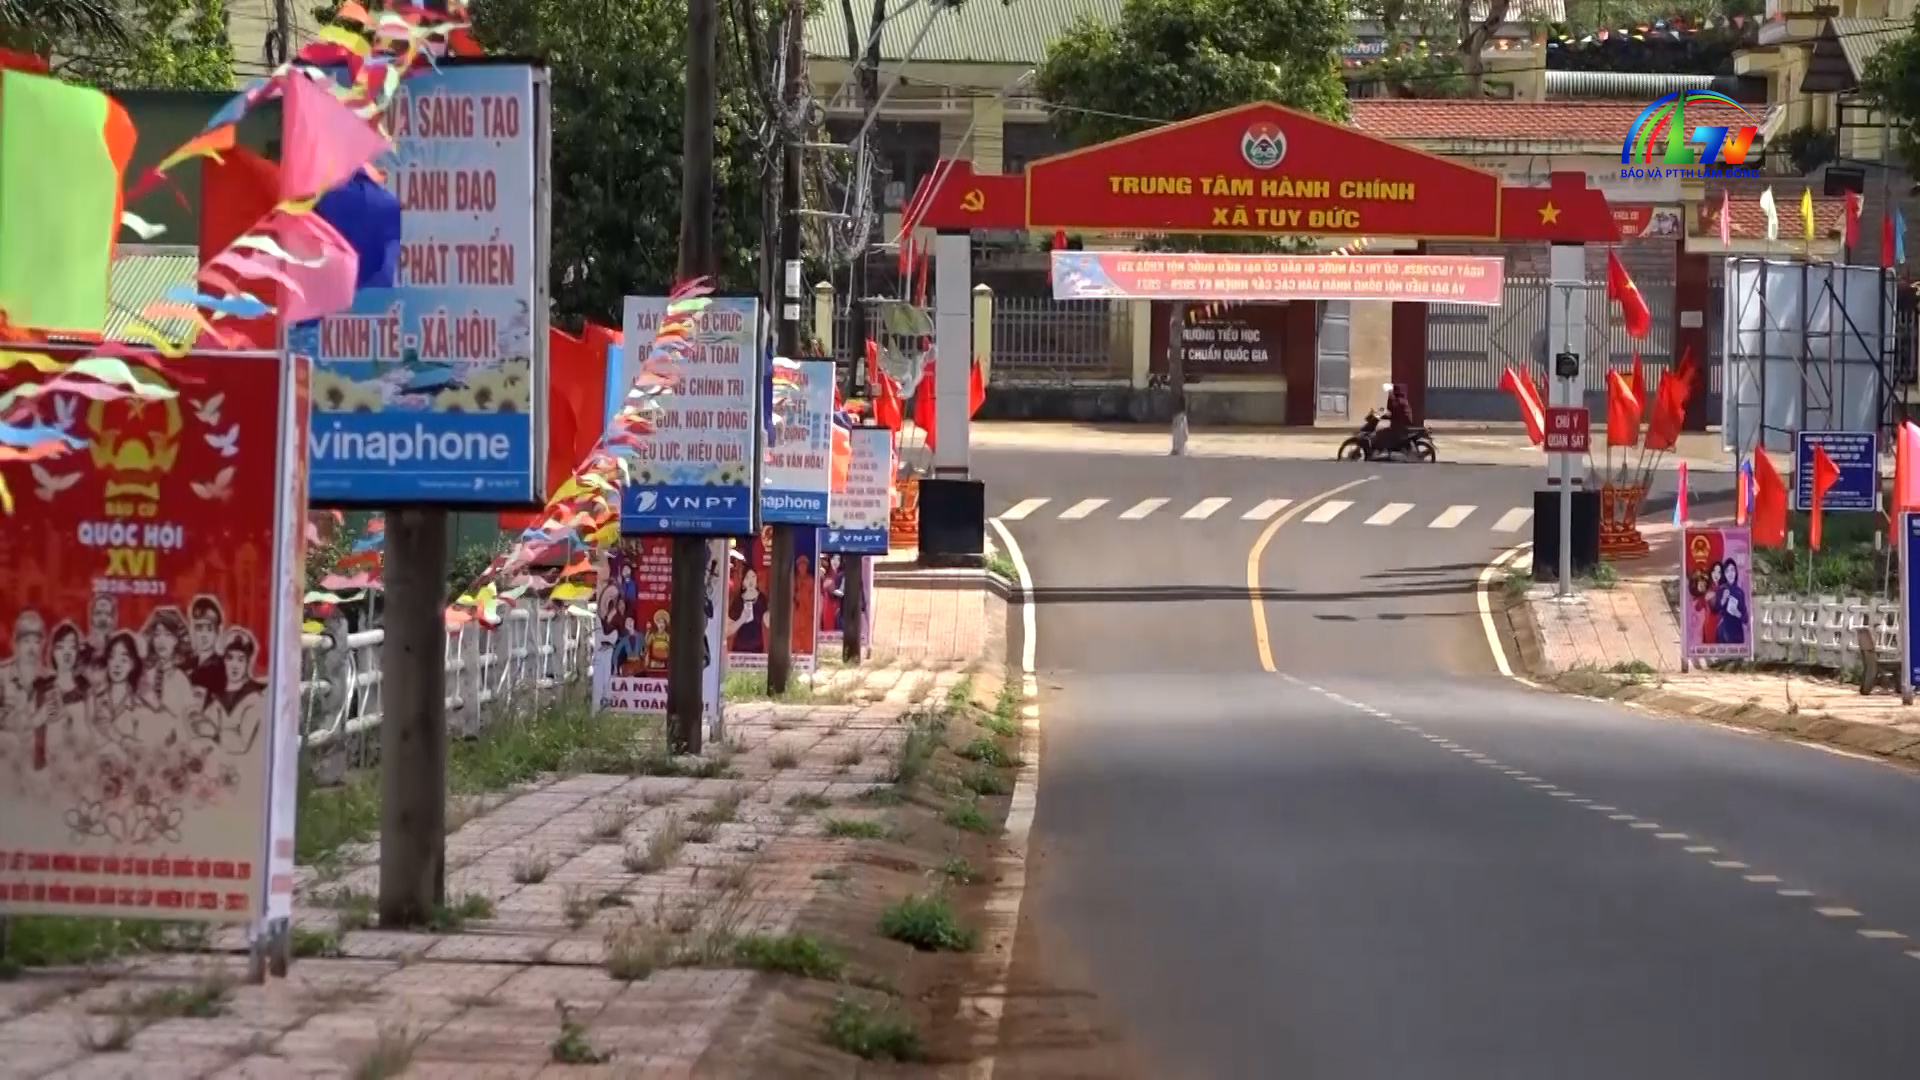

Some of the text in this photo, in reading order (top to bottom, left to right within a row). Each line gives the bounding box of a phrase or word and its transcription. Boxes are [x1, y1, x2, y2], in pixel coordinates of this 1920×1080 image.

[418, 88, 474, 137] SÁNG
[481, 96, 520, 148] TẠO
[396, 162, 496, 221] LÃNH ĐẠO
[1109, 174, 1415, 201] TRUNG TÂM HÀNH CHÍNH
[1212, 205, 1360, 228] XÃ TUY ĐỨC
[397, 227, 515, 285] PHÁT TRIỂN
[637, 308, 658, 330] XÂY
[713, 309, 742, 332] CHỨC
[321, 318, 370, 358] KINH
[376, 302, 400, 358] TẾ
[421, 309, 449, 358] XÃ
[456, 309, 496, 367] HỘI!
[710, 342, 739, 364] TOÀN
[1251, 349, 1269, 361] GIA
[690, 375, 723, 396] CHÍNH
[727, 378, 744, 401] TRỊ
[685, 411, 714, 433] HOẠT
[717, 407, 748, 432] ĐỘNG
[308, 421, 510, 466] vinaphone
[687, 439, 713, 465] HIỆU
[665, 496, 737, 509] VNPT
[77, 518, 184, 554] QUỐC HỘI
[104, 548, 155, 577] XVI
